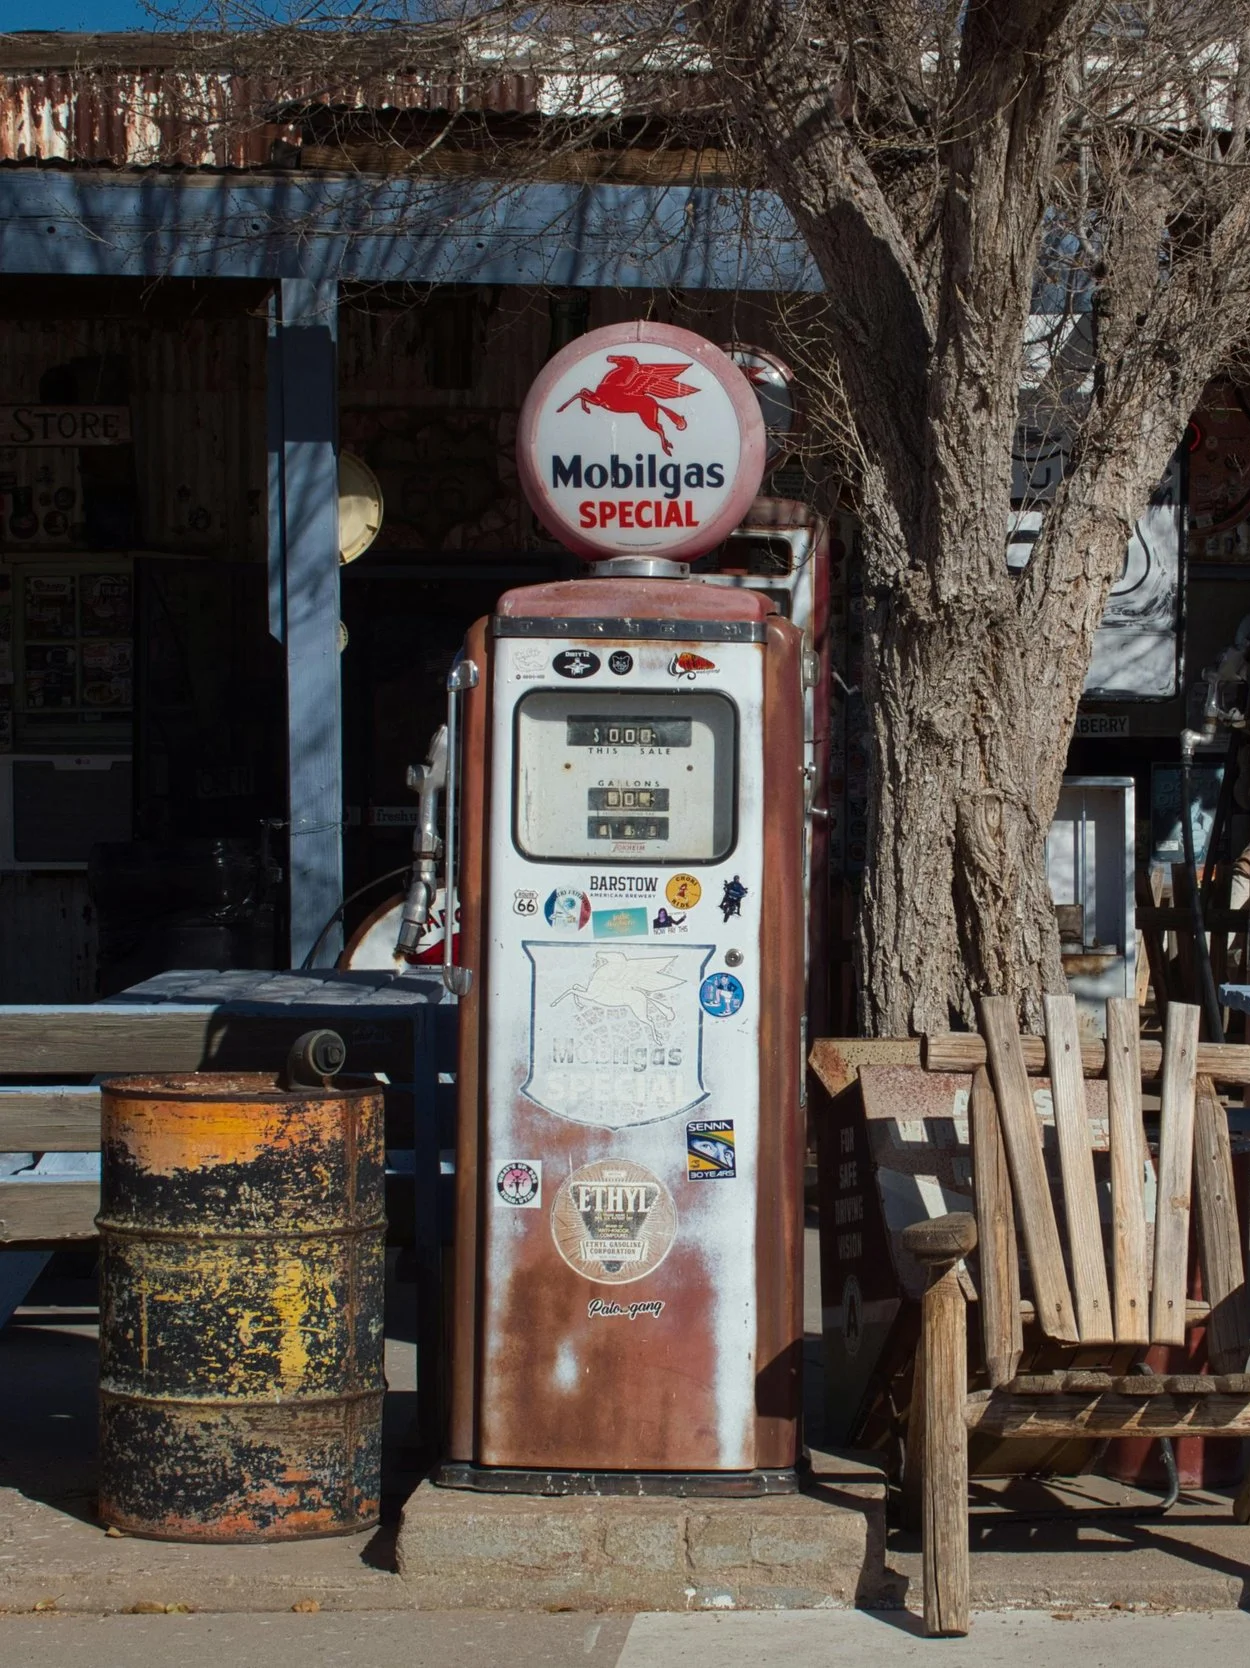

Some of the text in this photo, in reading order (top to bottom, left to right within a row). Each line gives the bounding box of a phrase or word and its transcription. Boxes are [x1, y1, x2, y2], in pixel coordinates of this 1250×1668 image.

[10, 408, 120, 443] STORE
[552, 454, 725, 499] Mobilgas
[579, 500, 699, 529] SPECIAL
[588, 747, 618, 755] THIS
[590, 876, 659, 891] BARSTOW
[517, 899, 536, 913] 66
[671, 899, 690, 907] RIDE
[546, 1072, 687, 1101] SPECIAL
[688, 1121, 732, 1132] SENNA
[840, 1126, 855, 1153] FOR
[839, 1160, 858, 1190] SAFE
[579, 1186, 651, 1213] ETHYL
